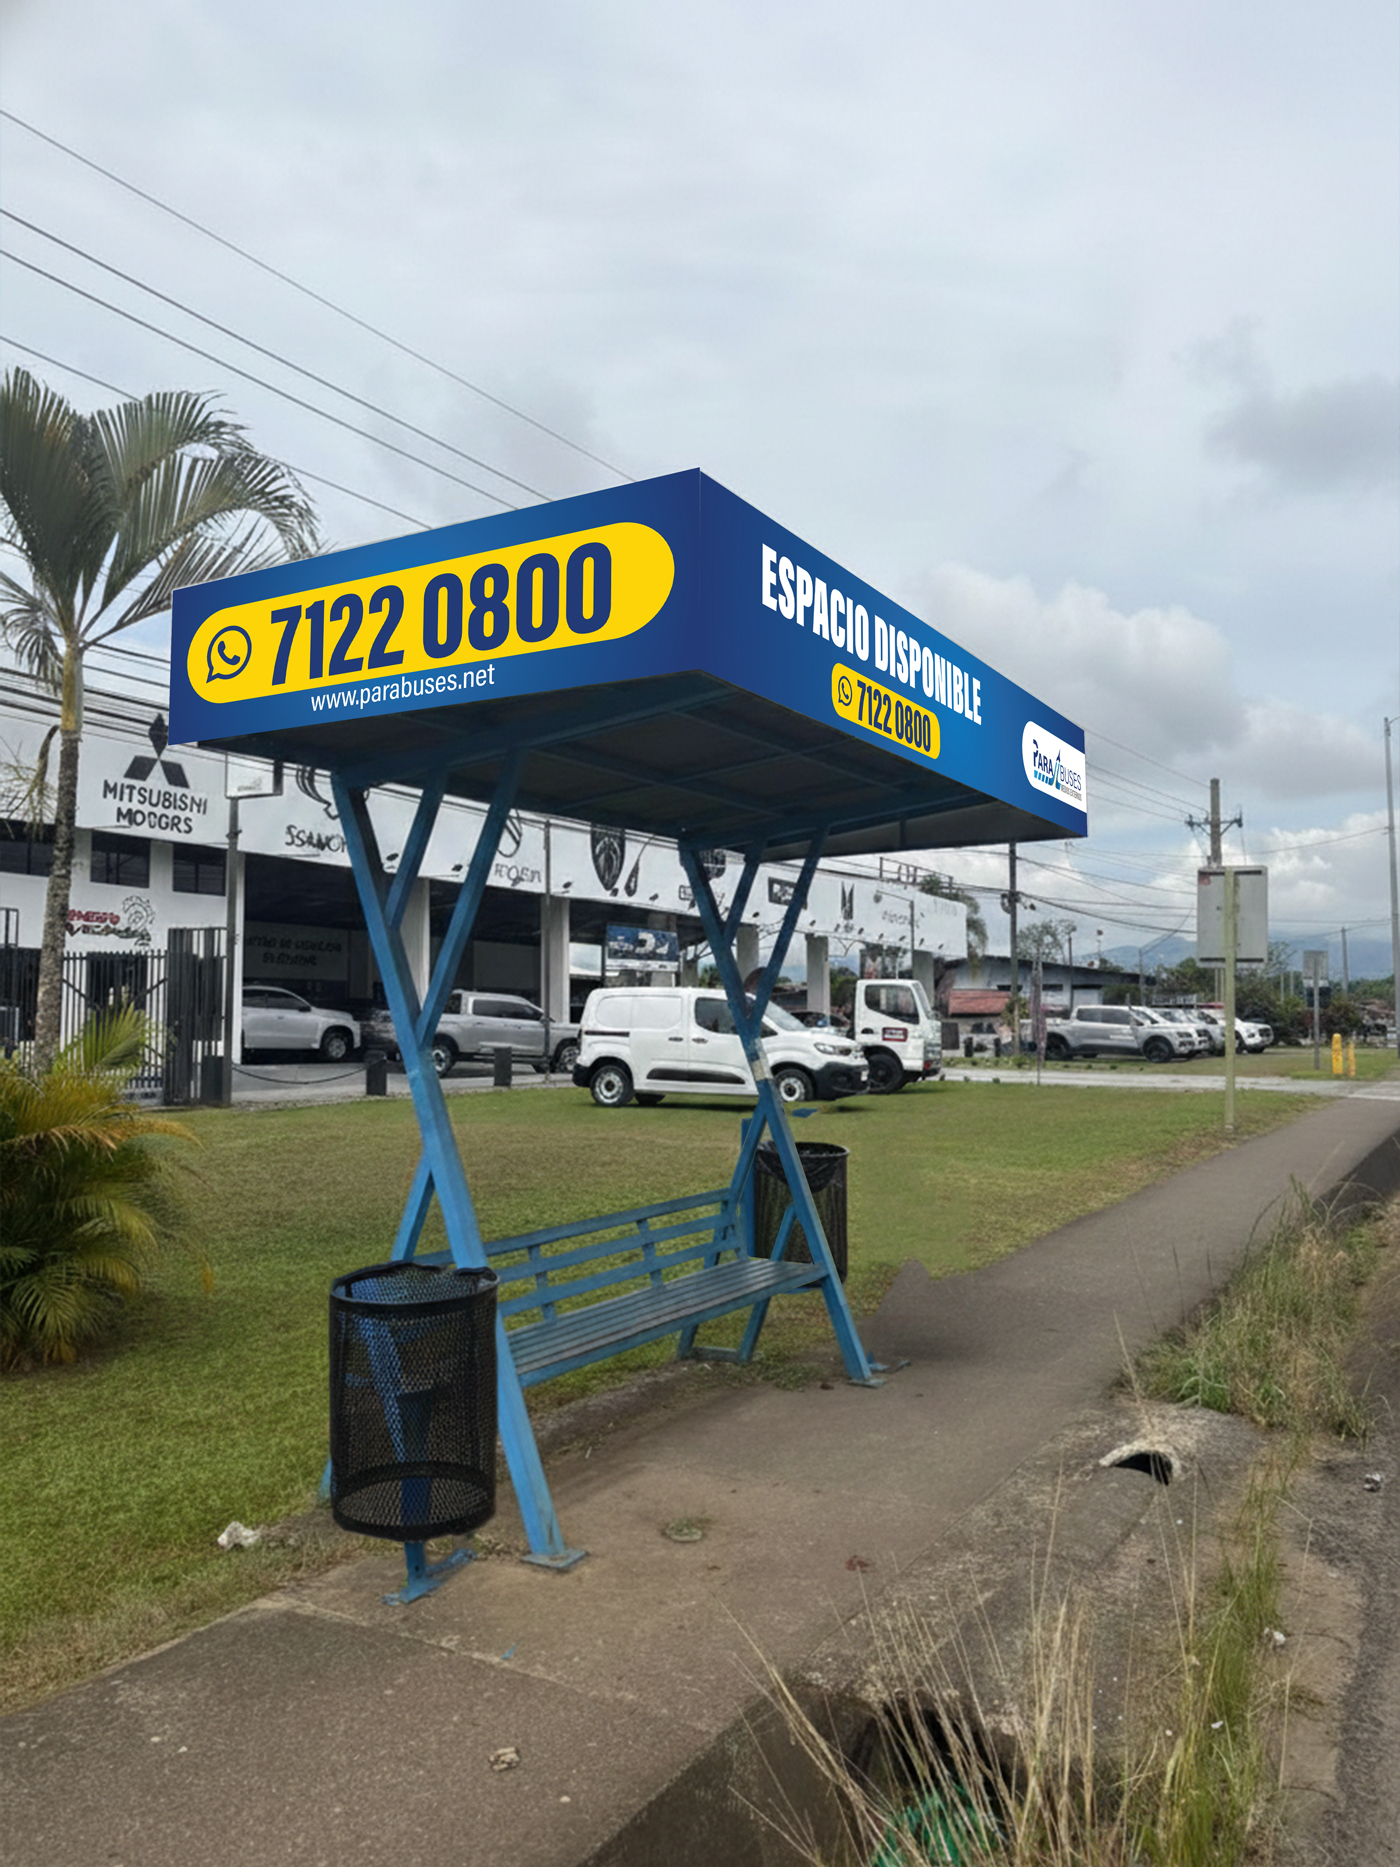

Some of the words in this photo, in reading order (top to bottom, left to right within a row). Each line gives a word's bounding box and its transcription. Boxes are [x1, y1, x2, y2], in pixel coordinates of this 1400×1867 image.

[271, 585, 405, 687] 7122
[423, 542, 612, 660] 0800
[762, 543, 870, 662] ESPACIO
[874, 614, 982, 726] DISPONIBLE
[311, 663, 495, 711] www.parabuses.net
[857, 679, 892, 735] 7122
[895, 700, 931, 753] 0800
